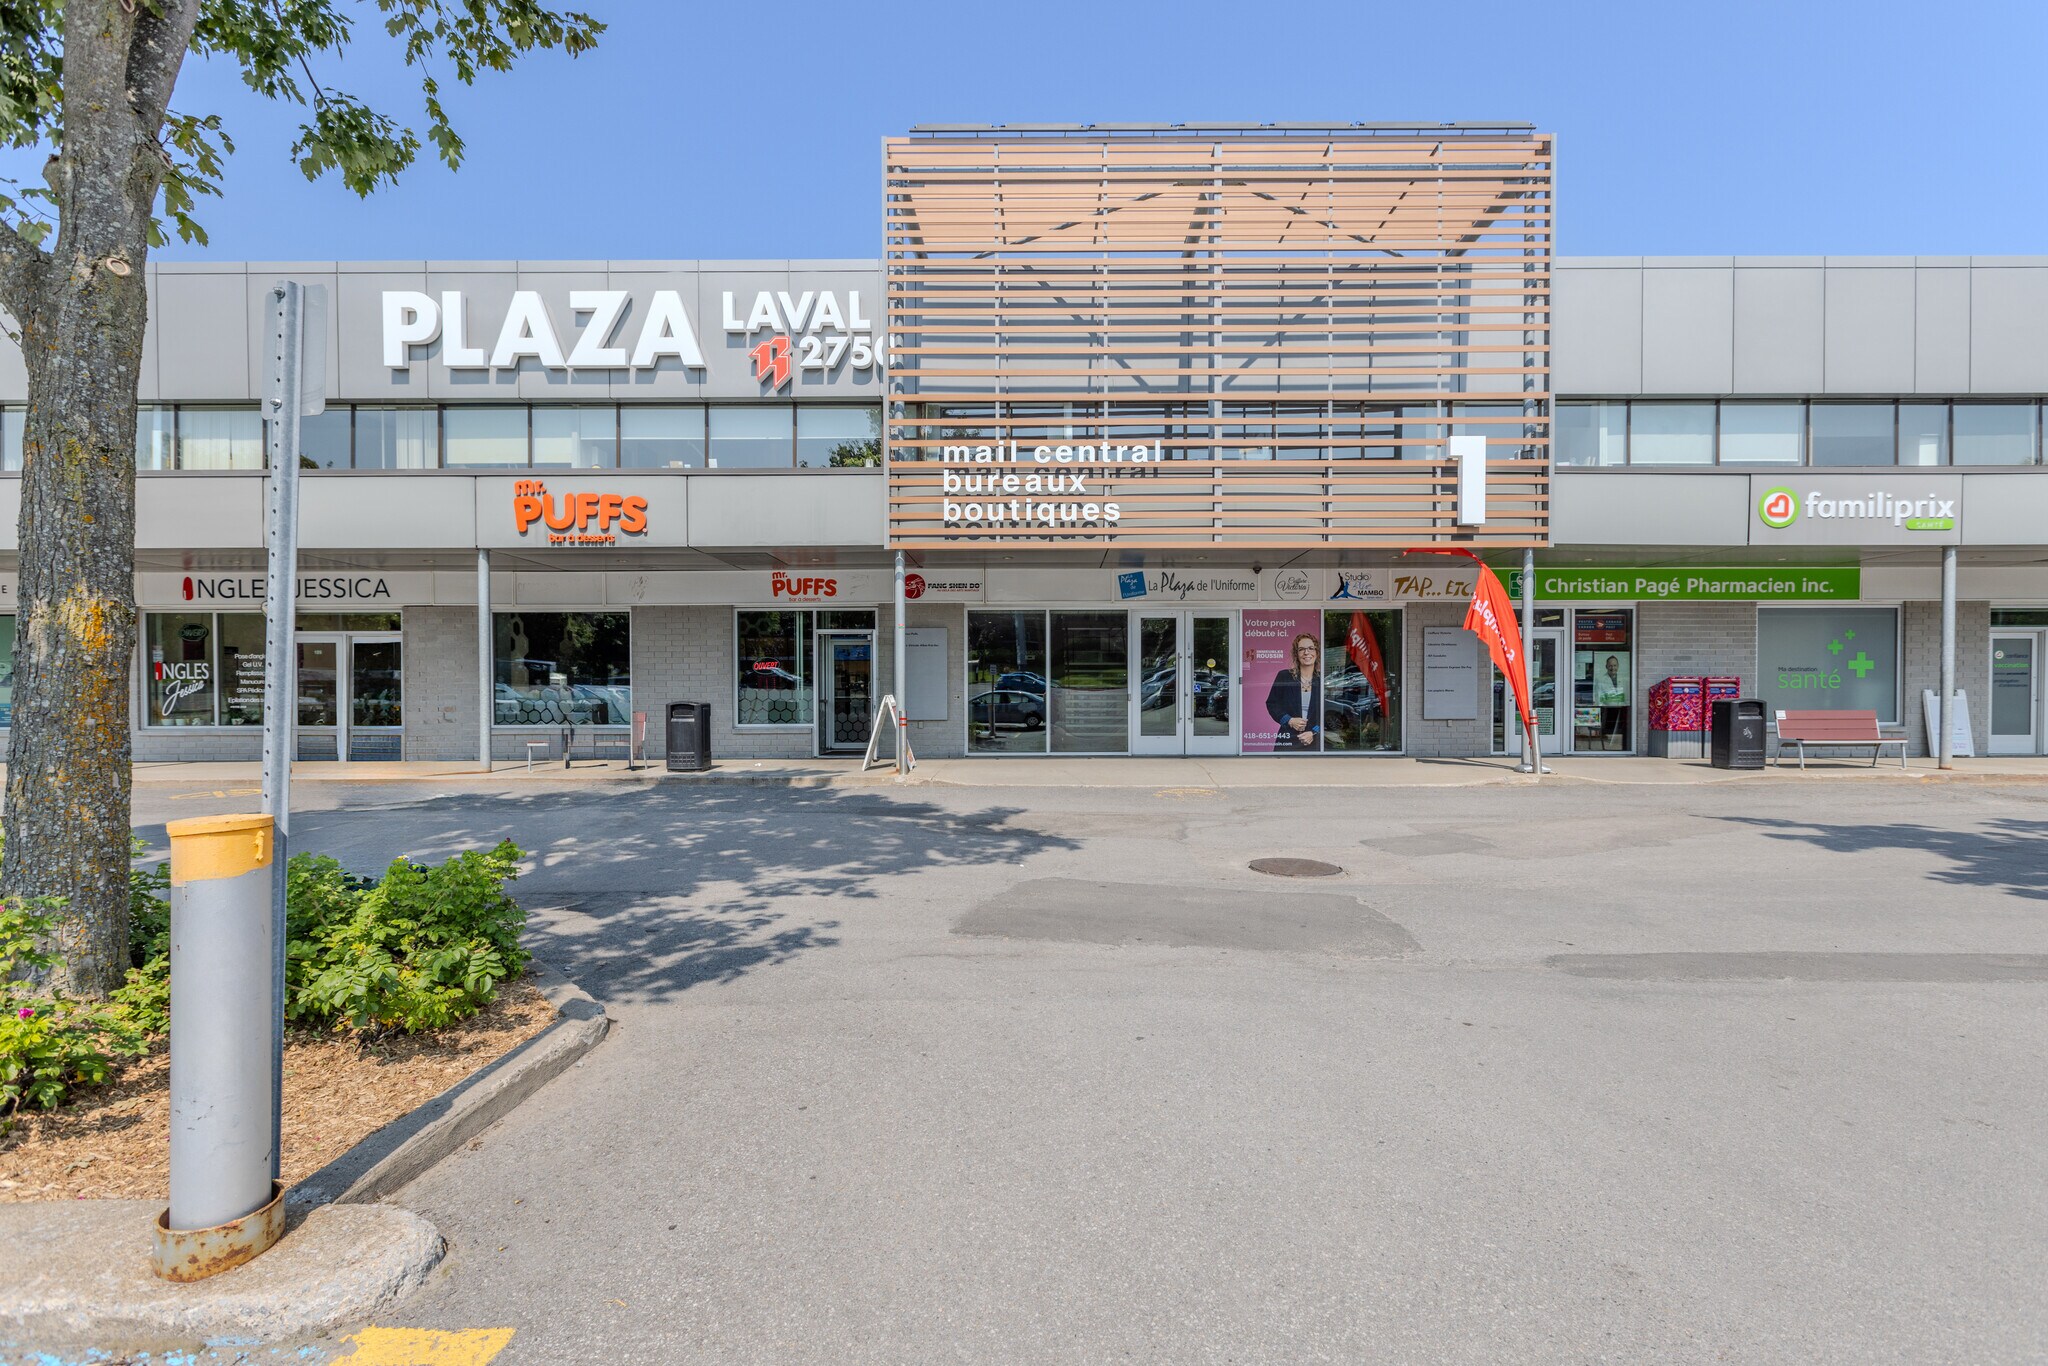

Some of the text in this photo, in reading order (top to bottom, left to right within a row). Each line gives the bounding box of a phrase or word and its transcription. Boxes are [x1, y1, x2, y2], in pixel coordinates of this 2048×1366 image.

[723, 290, 872, 332] LAVAL
[382, 290, 706, 368] PLAZA
[943, 440, 1161, 463] mail central
[514, 480, 547, 496] mr.
[943, 469, 1086, 492] bureaux
[1446, 435, 1486, 525] 1
[514, 493, 647, 533] PUFFS
[943, 498, 1121, 527] boutiques
[1805, 492, 1954, 526] familiprix
[772, 571, 788, 579] mr.
[1148, 571, 1255, 600] La Plaza de l'Uniforme
[1344, 571, 1370, 581] Studio
[1545, 576, 1835, 597] Christian Pagé Pharmacien inc.
[296, 578, 391, 598] JESSICA
[772, 578, 837, 597] PUFFS
[1245, 619, 1296, 628] Votre projet
[1245, 629, 1289, 637] débute ici.
[1777, 668, 1841, 689] santé
[162, 680, 205, 717] Jessica
